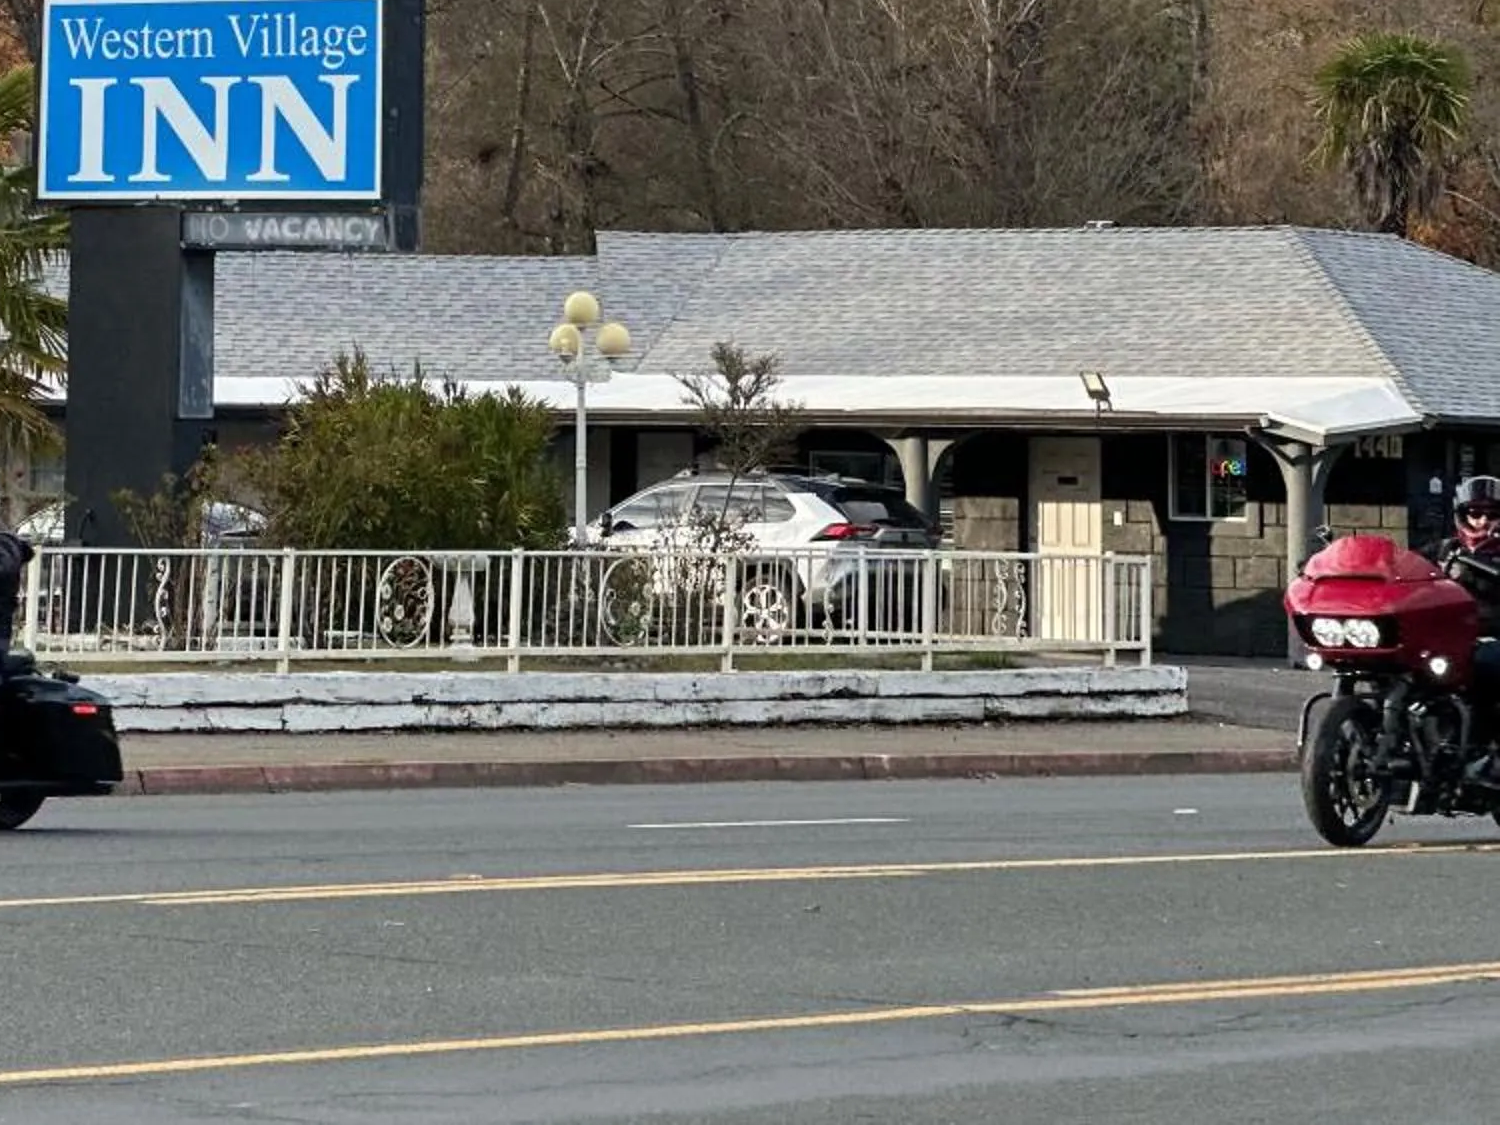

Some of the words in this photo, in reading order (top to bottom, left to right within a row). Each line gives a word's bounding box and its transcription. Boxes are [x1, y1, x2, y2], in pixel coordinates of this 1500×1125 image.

[61, 17, 214, 60] Western
[228, 12, 367, 70] Village
[67, 74, 361, 182] INN
[190, 215, 230, 244] NO
[244, 216, 380, 243] VACANCY
